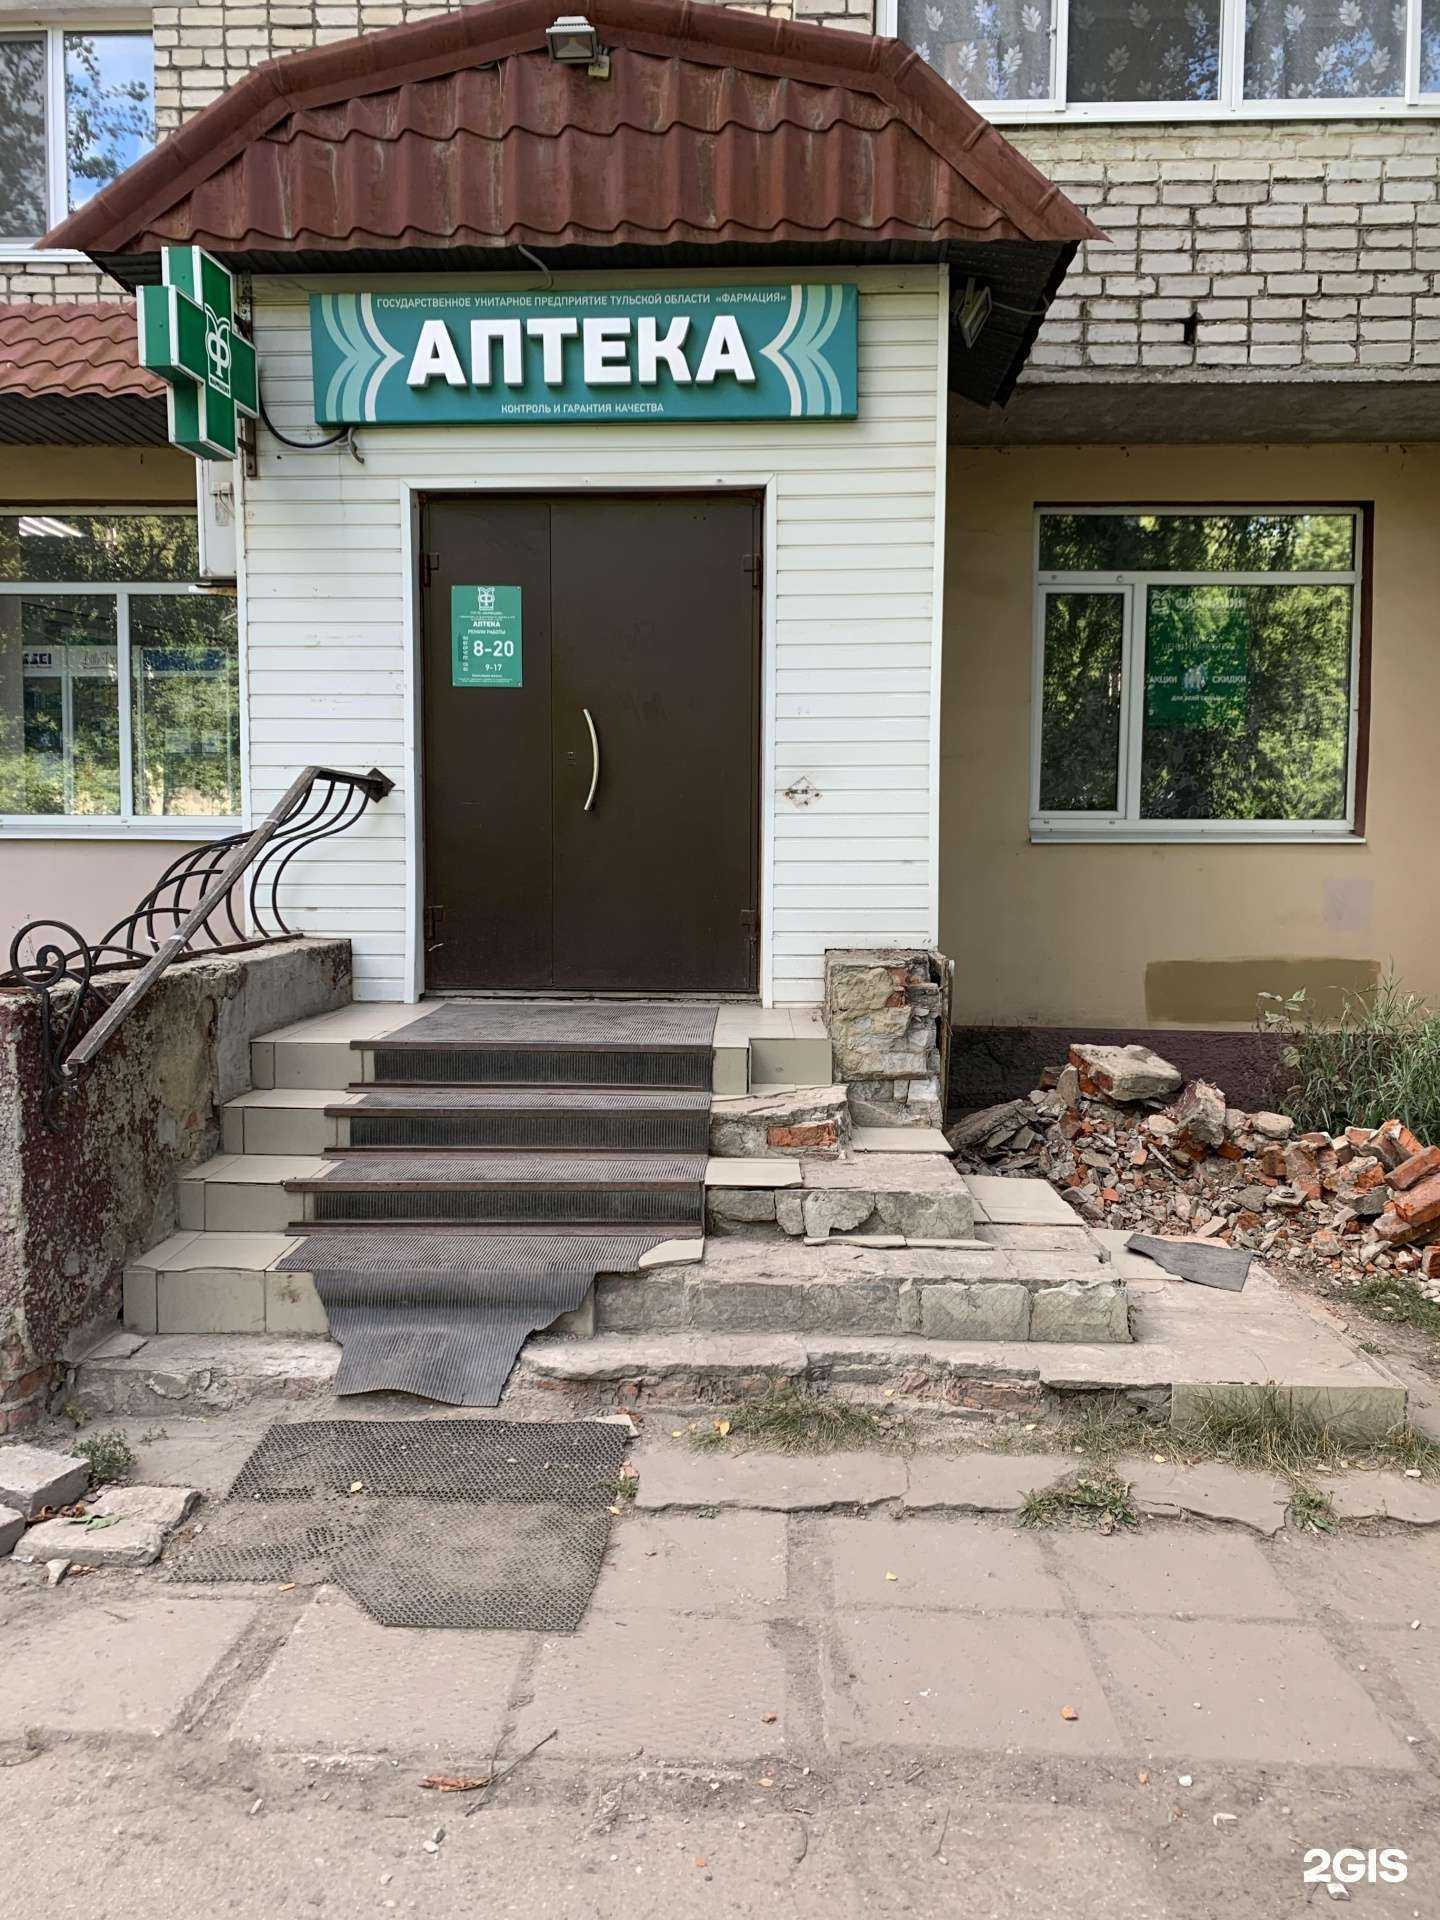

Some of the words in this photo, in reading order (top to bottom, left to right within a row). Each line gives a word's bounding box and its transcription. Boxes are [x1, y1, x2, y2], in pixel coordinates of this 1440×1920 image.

[377, 297, 471, 308] ГОСУДАРСТВЕННОЕ
[475, 296, 532, 306] УНИТАРНОЕ
[534, 294, 607, 307] ПРЕДПРИЯТИЕ
[610, 293, 662, 305] ТУЛЬСКОЙ
[664, 293, 710, 304] ОБЛАСТИ
[716, 292, 786, 304] «ФАРМАЦИЯ»
[406, 315, 756, 388] АПТЕКА
[502, 403, 551, 413] КОНТРОЛЬ
[553, 403, 561, 413] И
[563, 403, 612, 413] ГАРАНТИЯ
[615, 402, 664, 413] КАЧЕСТВА
[474, 640, 513, 656] 8-20
